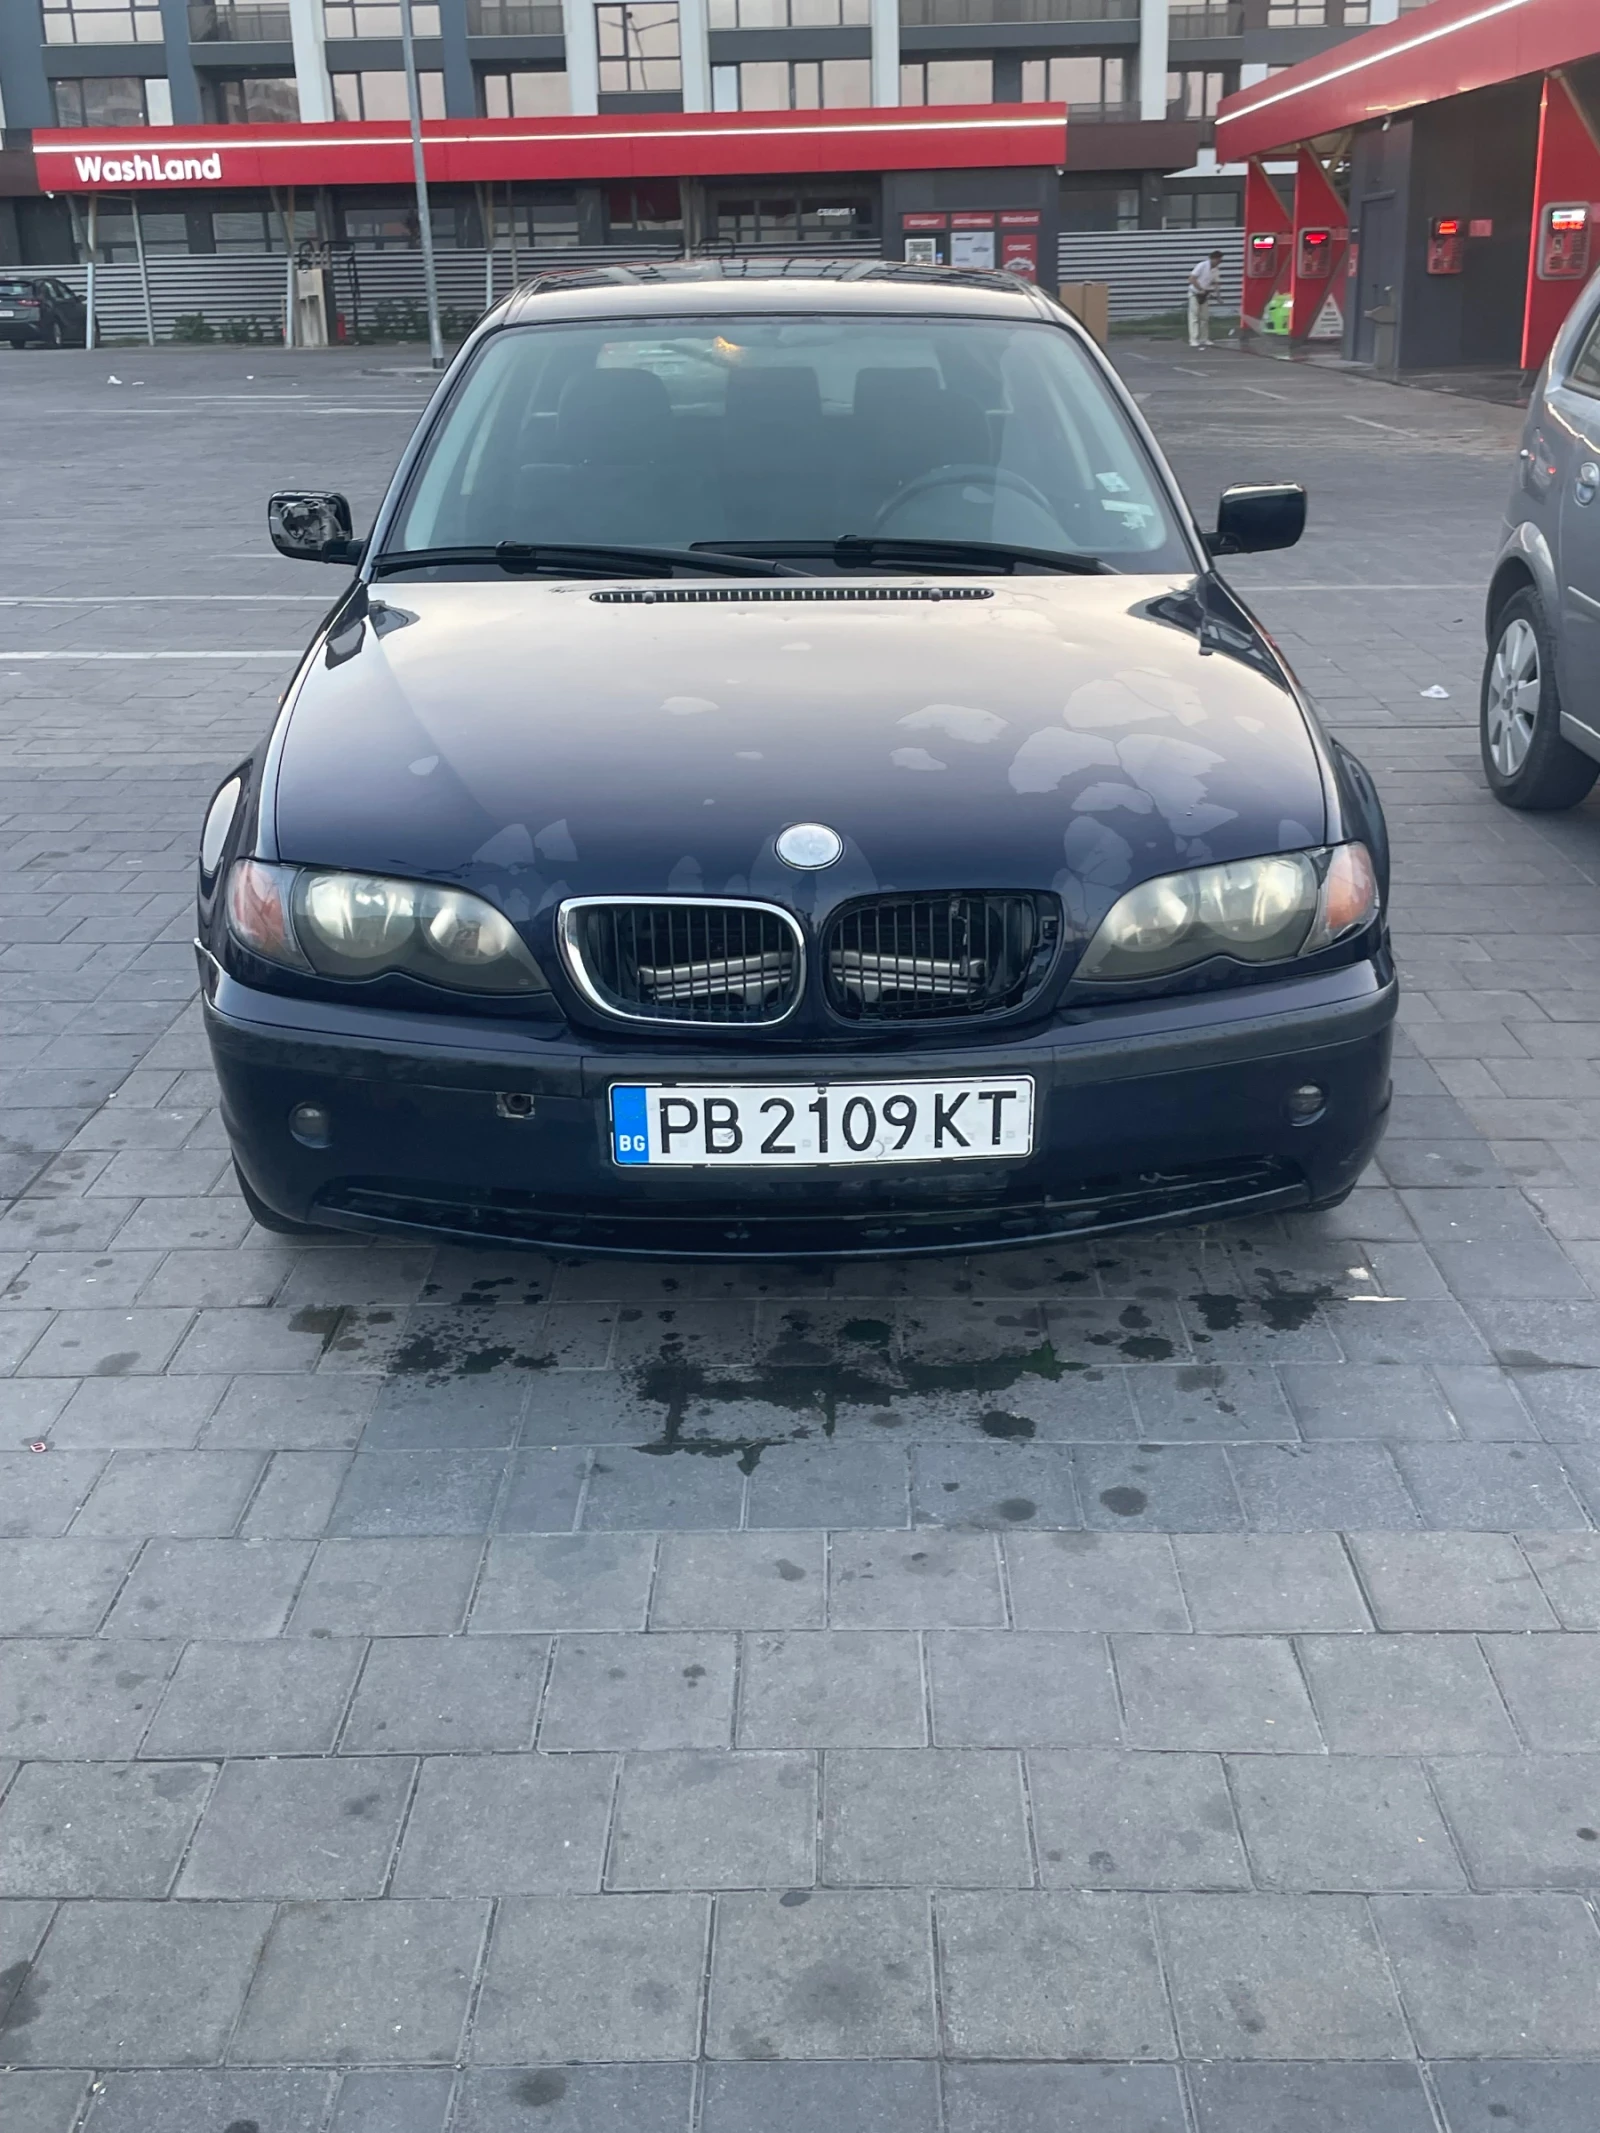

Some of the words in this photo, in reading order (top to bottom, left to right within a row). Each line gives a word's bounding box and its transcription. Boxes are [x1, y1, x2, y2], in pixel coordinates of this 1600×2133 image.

[74, 152, 222, 182] WashLand
[658, 1096, 743, 1155] PB
[759, 1094, 918, 1155] 2109
[934, 1090, 1018, 1149] KT
[619, 1134, 646, 1152] BG
